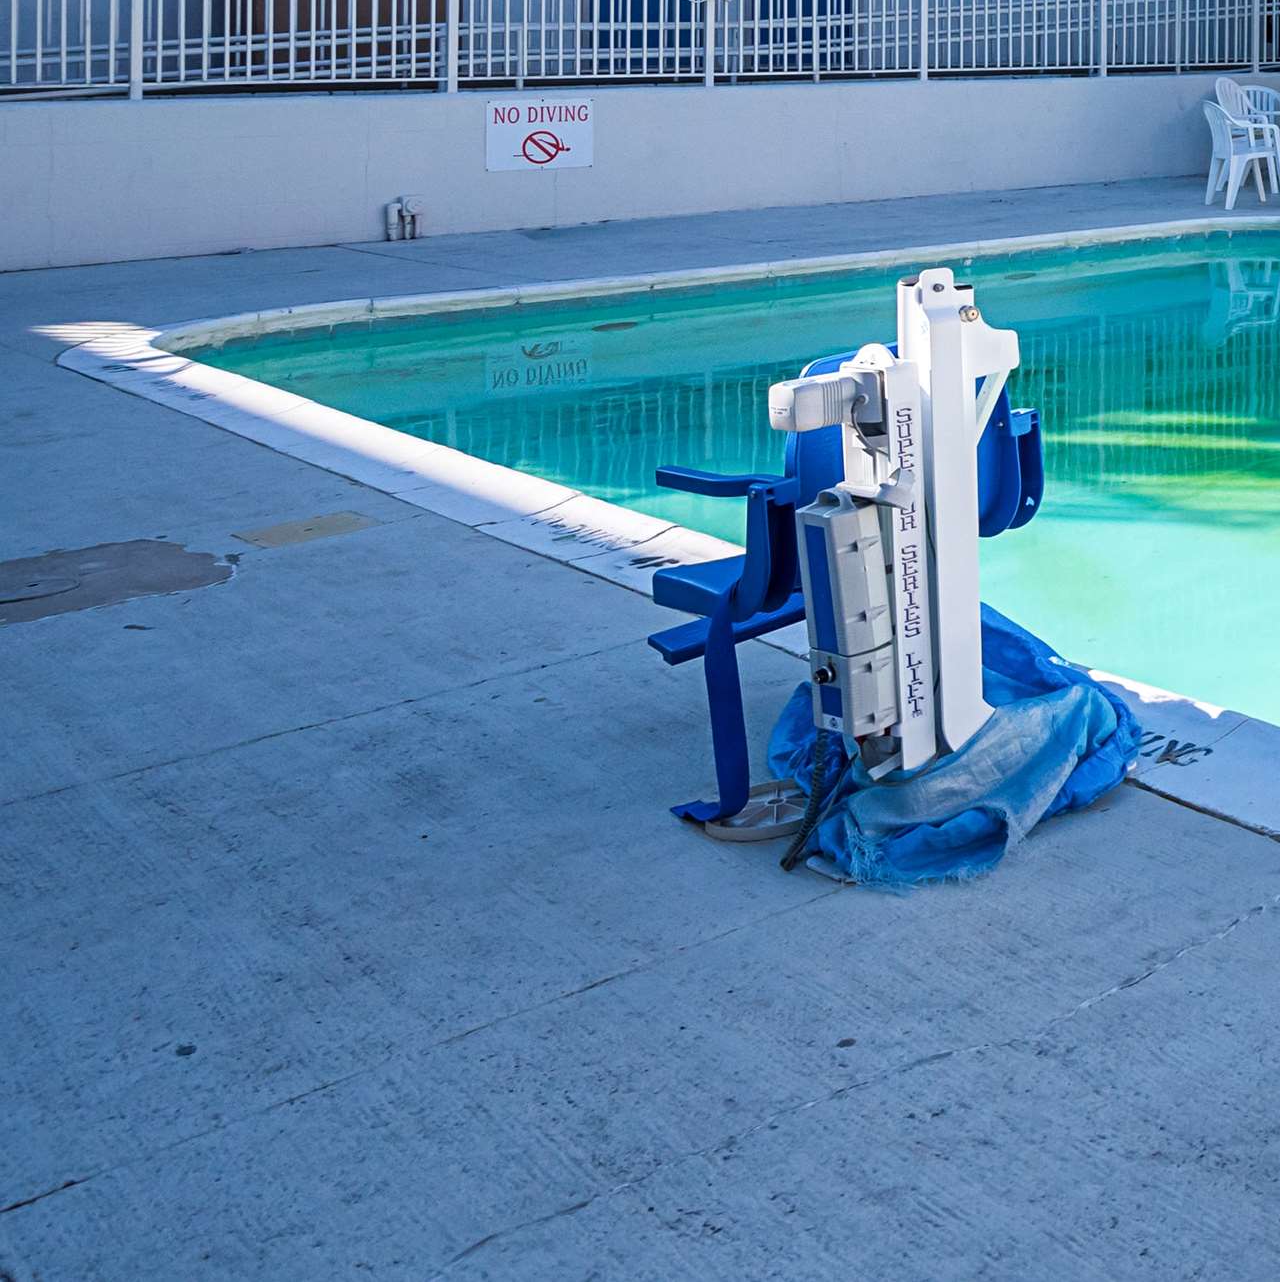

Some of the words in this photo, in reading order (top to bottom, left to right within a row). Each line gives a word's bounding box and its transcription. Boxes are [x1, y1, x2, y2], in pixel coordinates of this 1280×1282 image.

[494, 106, 520, 124] NO
[527, 104, 589, 123] DIVING
[901, 544, 921, 638] SERIES
[905, 653, 924, 713] LIFT
